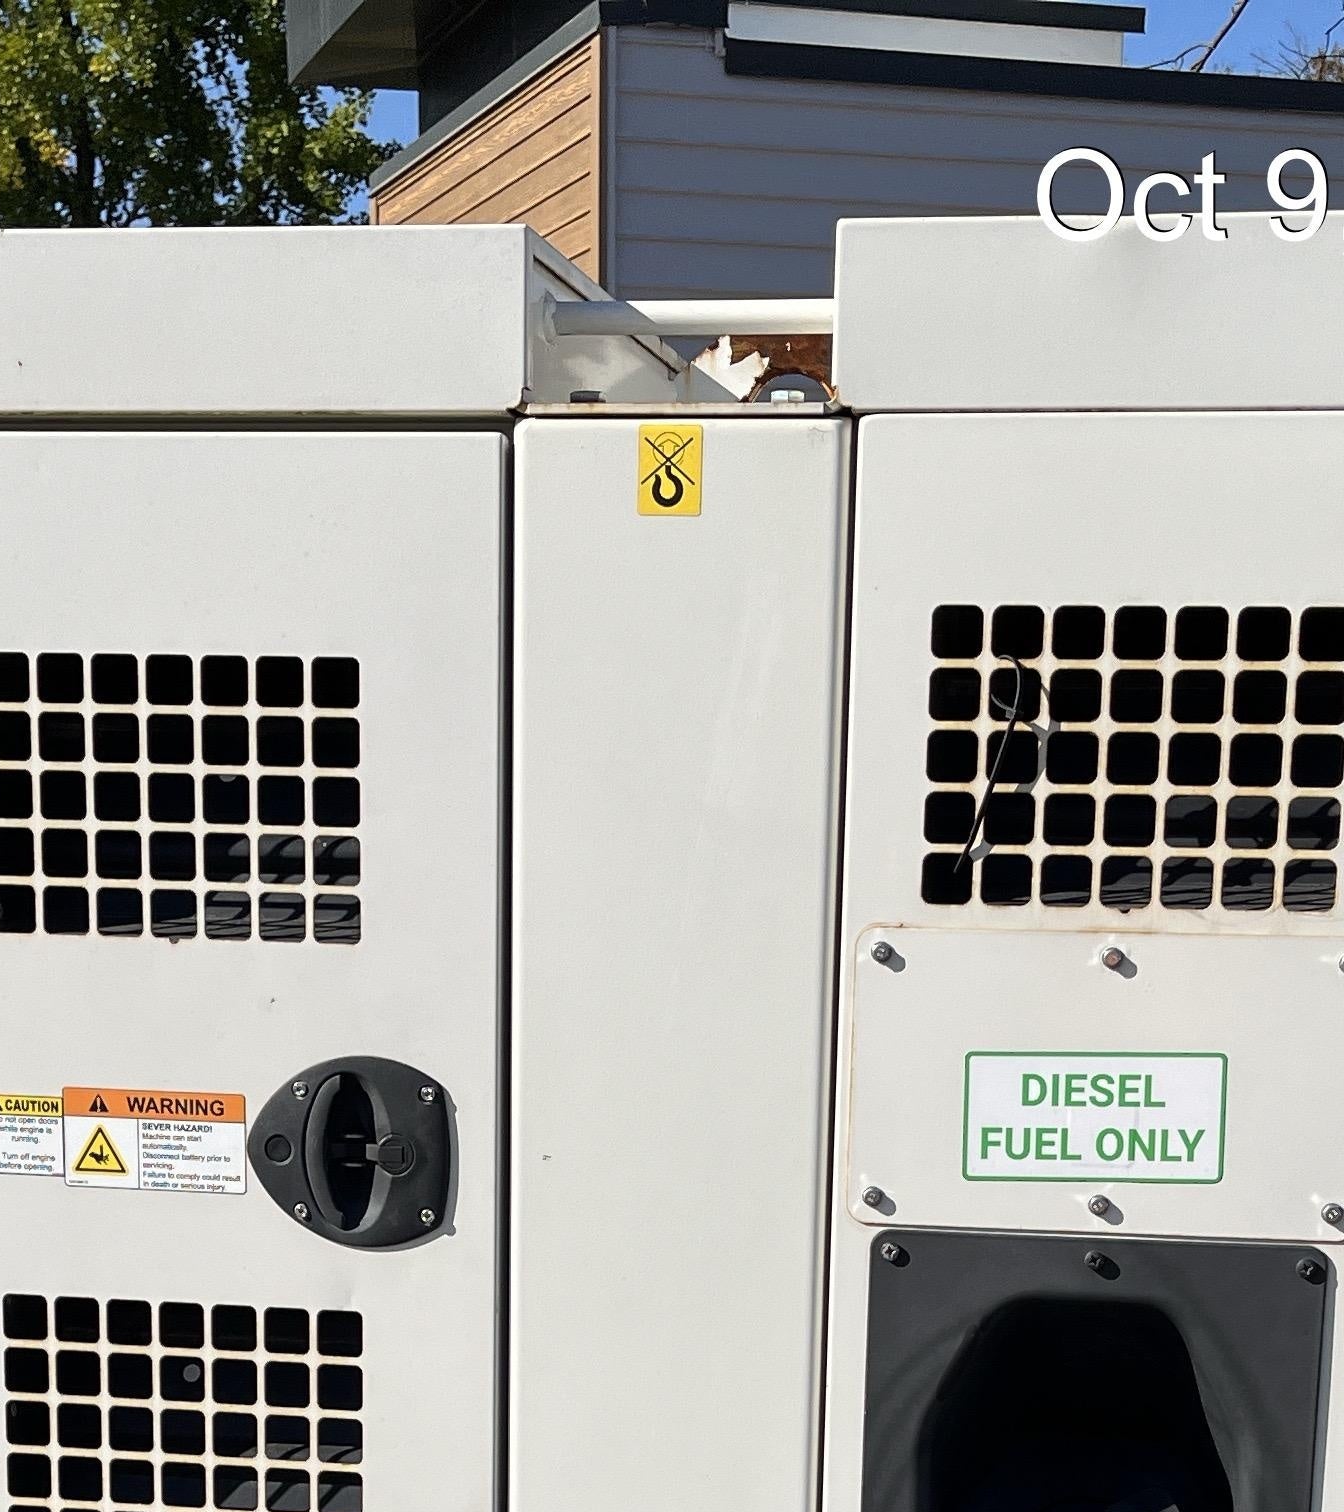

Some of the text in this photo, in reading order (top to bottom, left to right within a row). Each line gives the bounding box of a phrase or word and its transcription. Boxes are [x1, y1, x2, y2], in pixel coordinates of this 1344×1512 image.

[1021, 1073, 1166, 1108] DIESEL
[6, 1100, 58, 1113] CAUTION
[126, 1096, 225, 1117] WARNING
[18, 1117, 36, 1125] open
[38, 1117, 58, 1125] doors
[19, 1126, 44, 1135] engine
[142, 1122, 213, 1133] SEVER HAZARD!
[11, 1135, 41, 1144] running.
[142, 1133, 171, 1141] Machine
[980, 1127, 1206, 1162] FUEL ONLY
[1, 1152, 55, 1162] Turn off engine
[142, 1152, 180, 1160] Disconnect
[181, 1153, 205, 1162] battery
[207, 1155, 224, 1163] prior
[0, 1162, 55, 1172] before opening.
[143, 1171, 167, 1179] Failure
[176, 1173, 200, 1181] comply
[202, 1173, 220, 1181] could
[222, 1174, 241, 1182] result
[180, 1182, 205, 1190] serious
